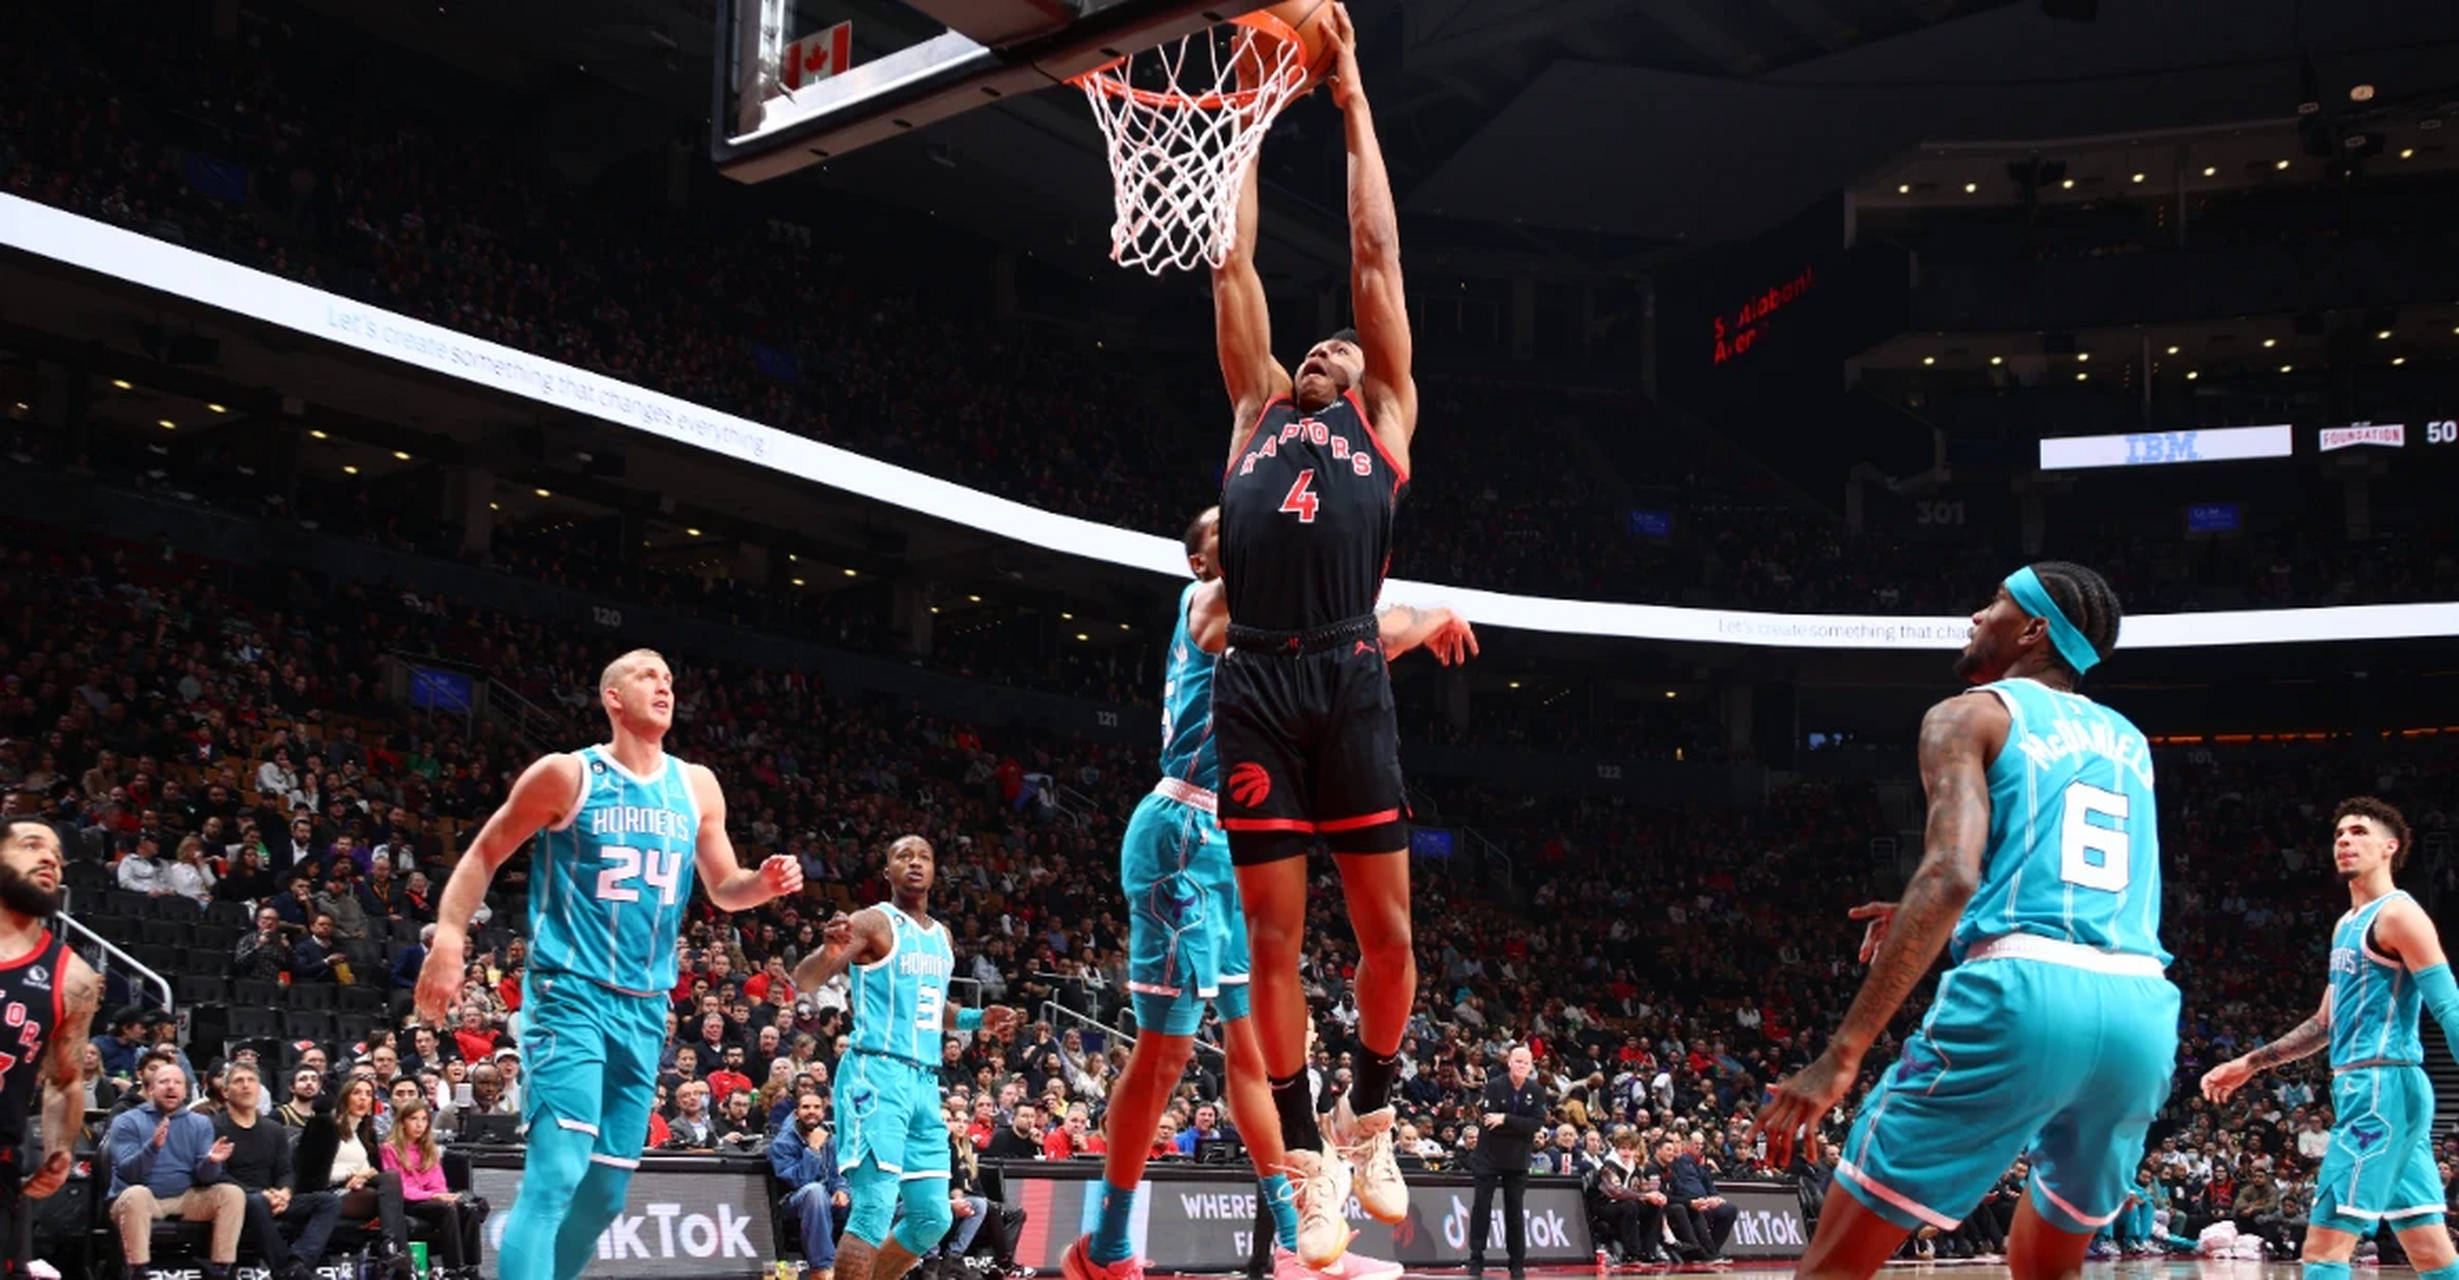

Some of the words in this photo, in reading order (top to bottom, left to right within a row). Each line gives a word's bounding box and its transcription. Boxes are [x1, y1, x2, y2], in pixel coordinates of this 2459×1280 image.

[1239, 418, 1372, 476] RAPTORS
[2126, 432, 2198, 464] IBM
[2324, 428, 2401, 446] FOUNDATION
[1278, 468, 1319, 522] 4
[1916, 499, 1966, 525] 301
[592, 605, 622, 628] 120
[1718, 618, 1754, 634] Let's
[1899, 625, 1932, 639] that
[592, 806, 689, 842] HORNETS
[2060, 781, 2129, 893] 6
[595, 845, 682, 906] 24
[916, 985, 942, 1031] 3
[1180, 1193, 1257, 1219] WHERE
